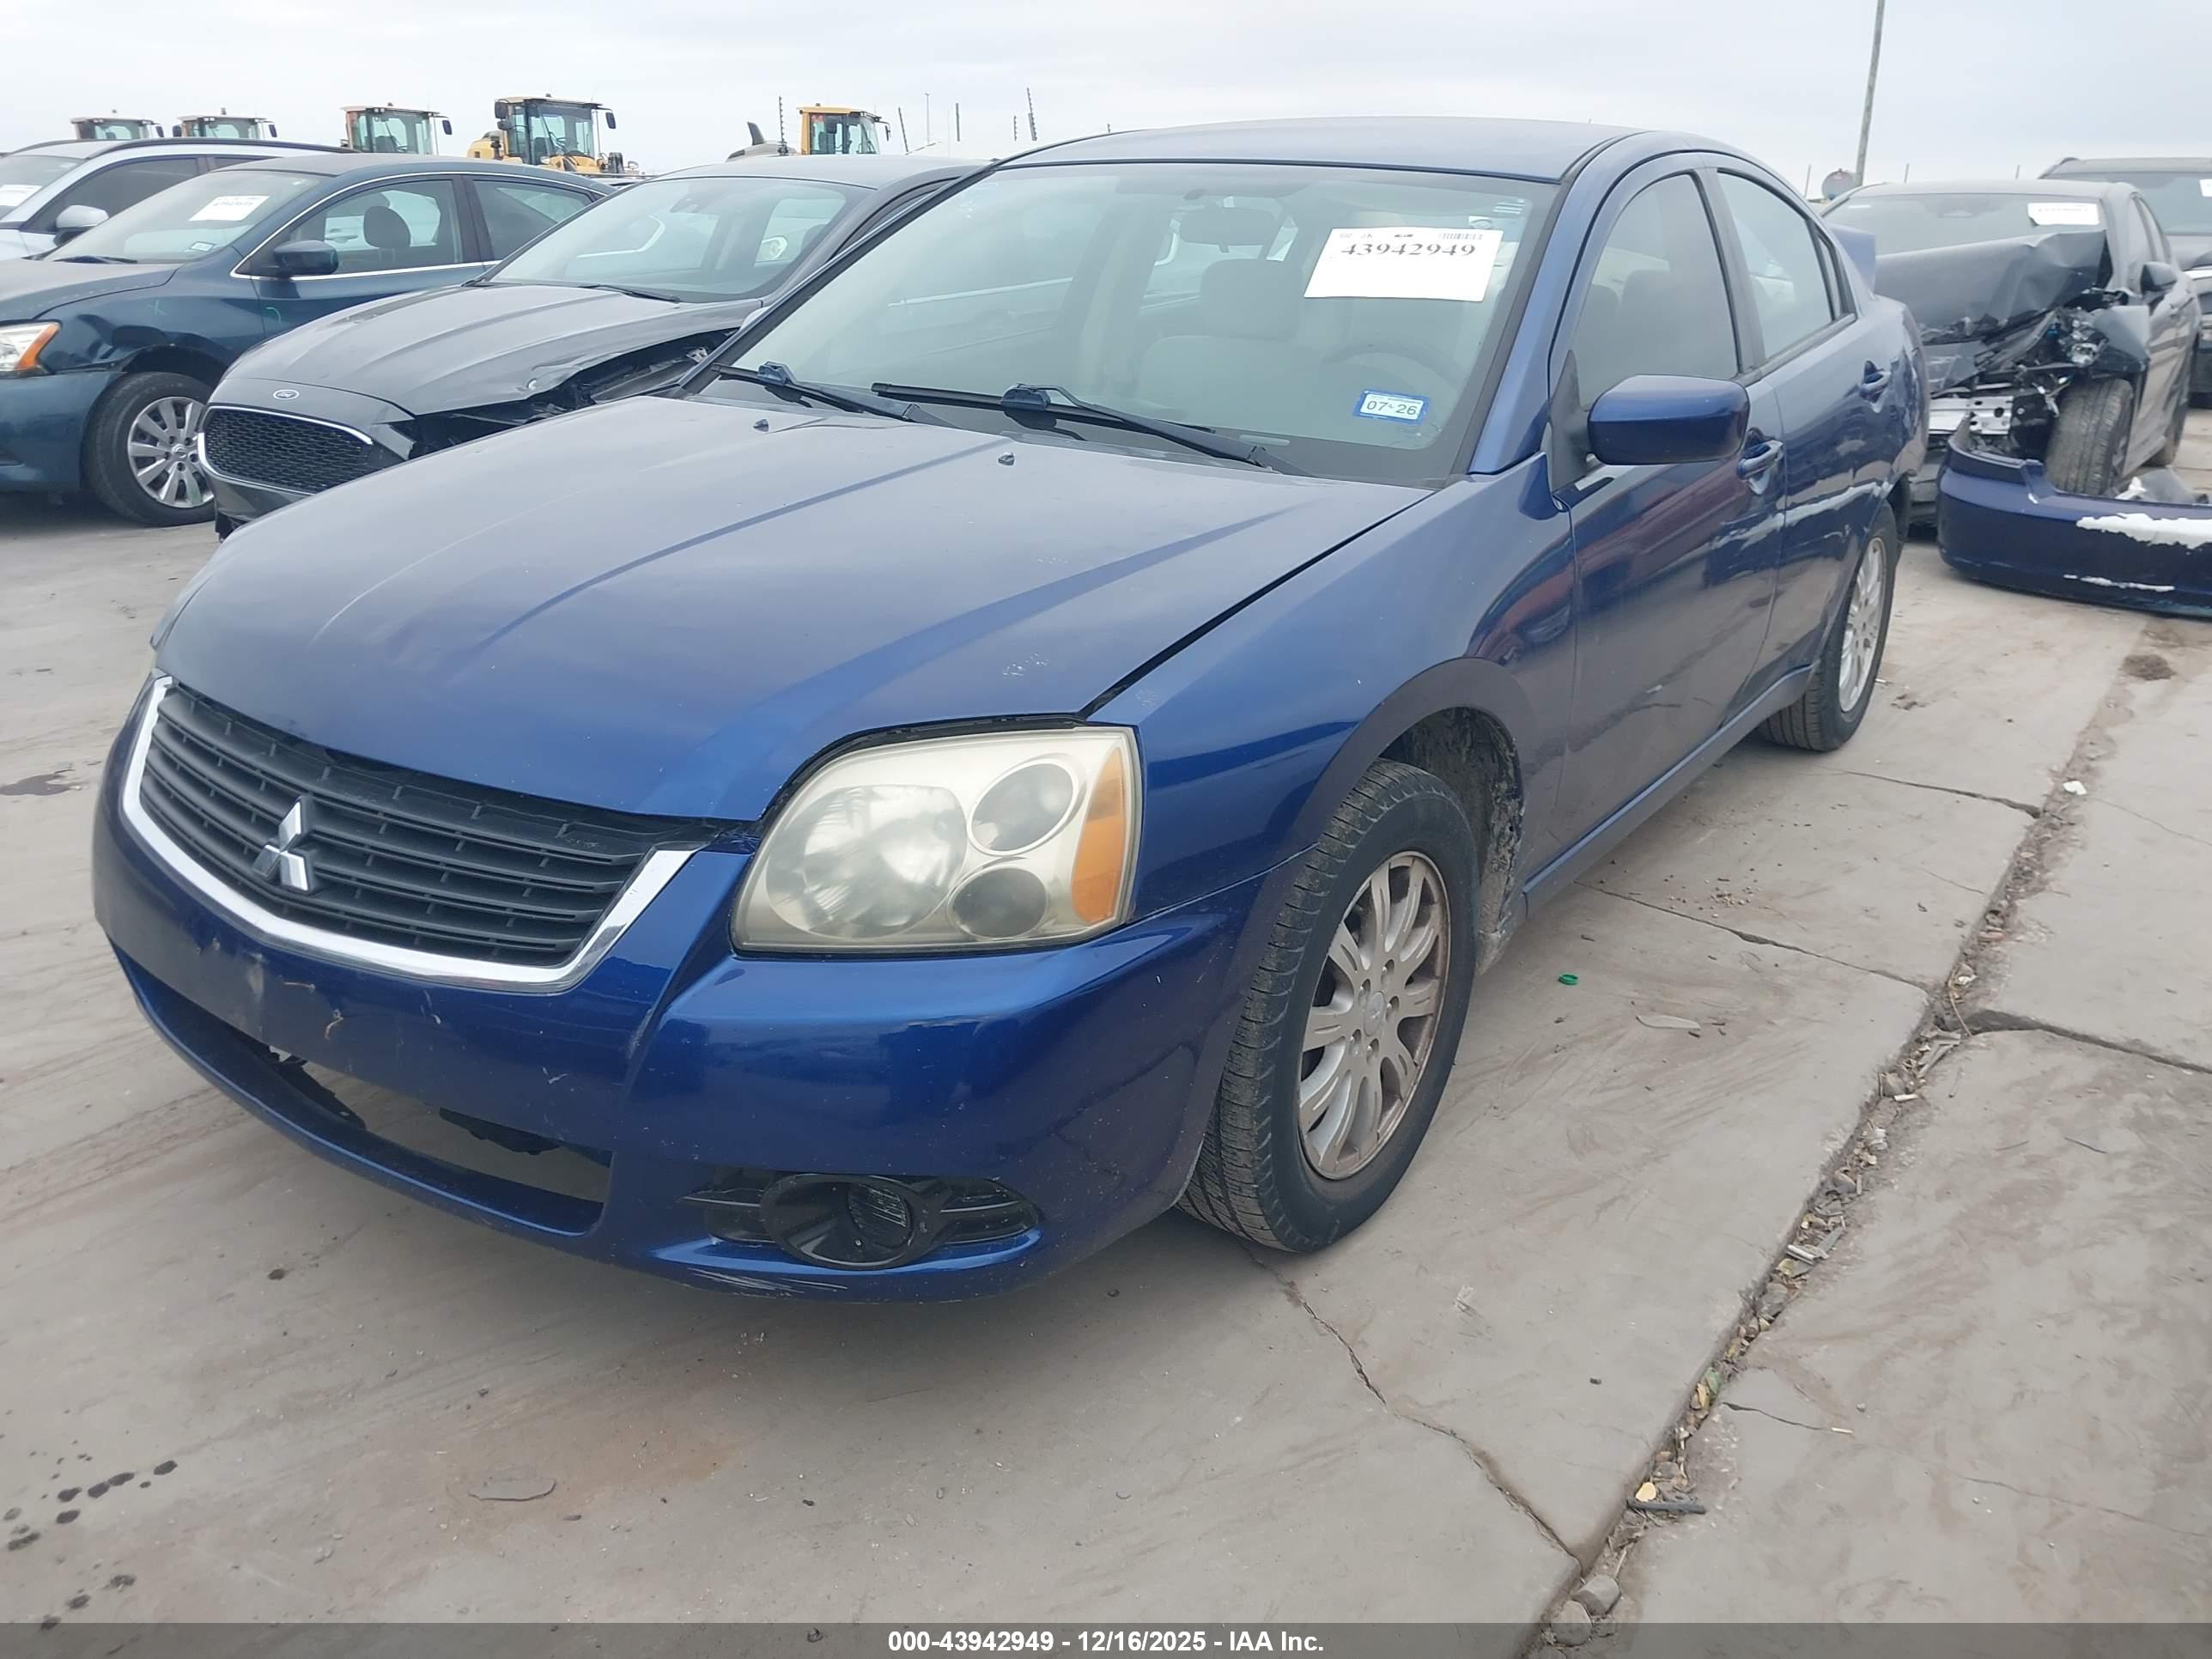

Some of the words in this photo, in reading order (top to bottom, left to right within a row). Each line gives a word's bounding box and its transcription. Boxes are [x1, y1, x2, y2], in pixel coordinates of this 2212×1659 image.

[1341, 243, 1475, 256] 43942949
[1366, 400, 1389, 411] 07
[1395, 404, 1418, 415] 26
